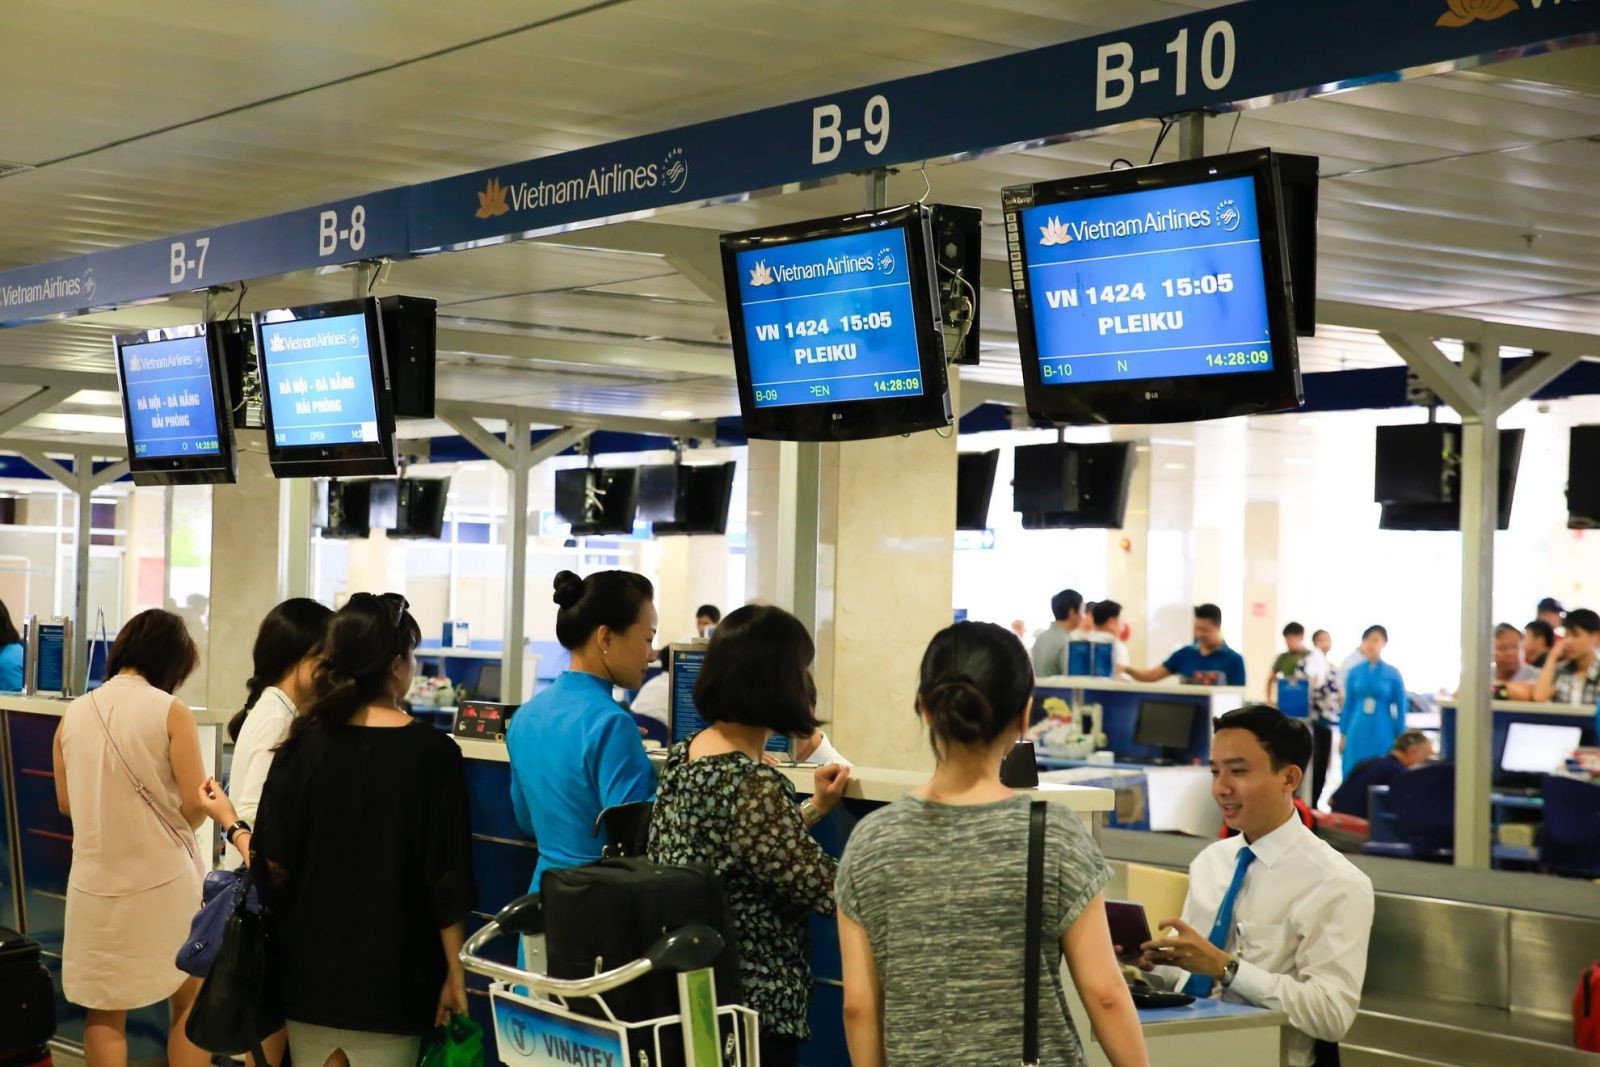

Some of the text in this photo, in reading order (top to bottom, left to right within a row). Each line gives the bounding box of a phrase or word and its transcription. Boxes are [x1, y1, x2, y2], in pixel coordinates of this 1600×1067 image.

[1095, 20, 1236, 111] B-10
[812, 94, 890, 165] B-9
[510, 163, 658, 211] Vietnam Airlines
[319, 205, 366, 257] B-8
[1071, 209, 1211, 241] Vietnam Airlines
[170, 237, 210, 285] B-7
[773, 255, 874, 283] Vietnam Airlines
[2, 285, 42, 307] Vietnam
[43, 276, 81, 299] Airlines
[1045, 273, 1234, 308] VN 1424 15:05
[755, 312, 892, 341] VN 1424 15:05
[1098, 311, 1184, 335] PLEIKU
[285, 336, 318, 350] Vietnam
[318, 331, 346, 347] Airlines
[794, 343, 857, 364] PLEIKU
[141, 357, 168, 369] Vietnam
[168, 354, 192, 368] Airlines
[1043, 351, 1269, 377] B-10 N 14:28:09
[756, 389, 777, 401] B-09
[873, 378, 919, 392] 14:28:09
[542, 1032, 613, 1067] VINATEX
